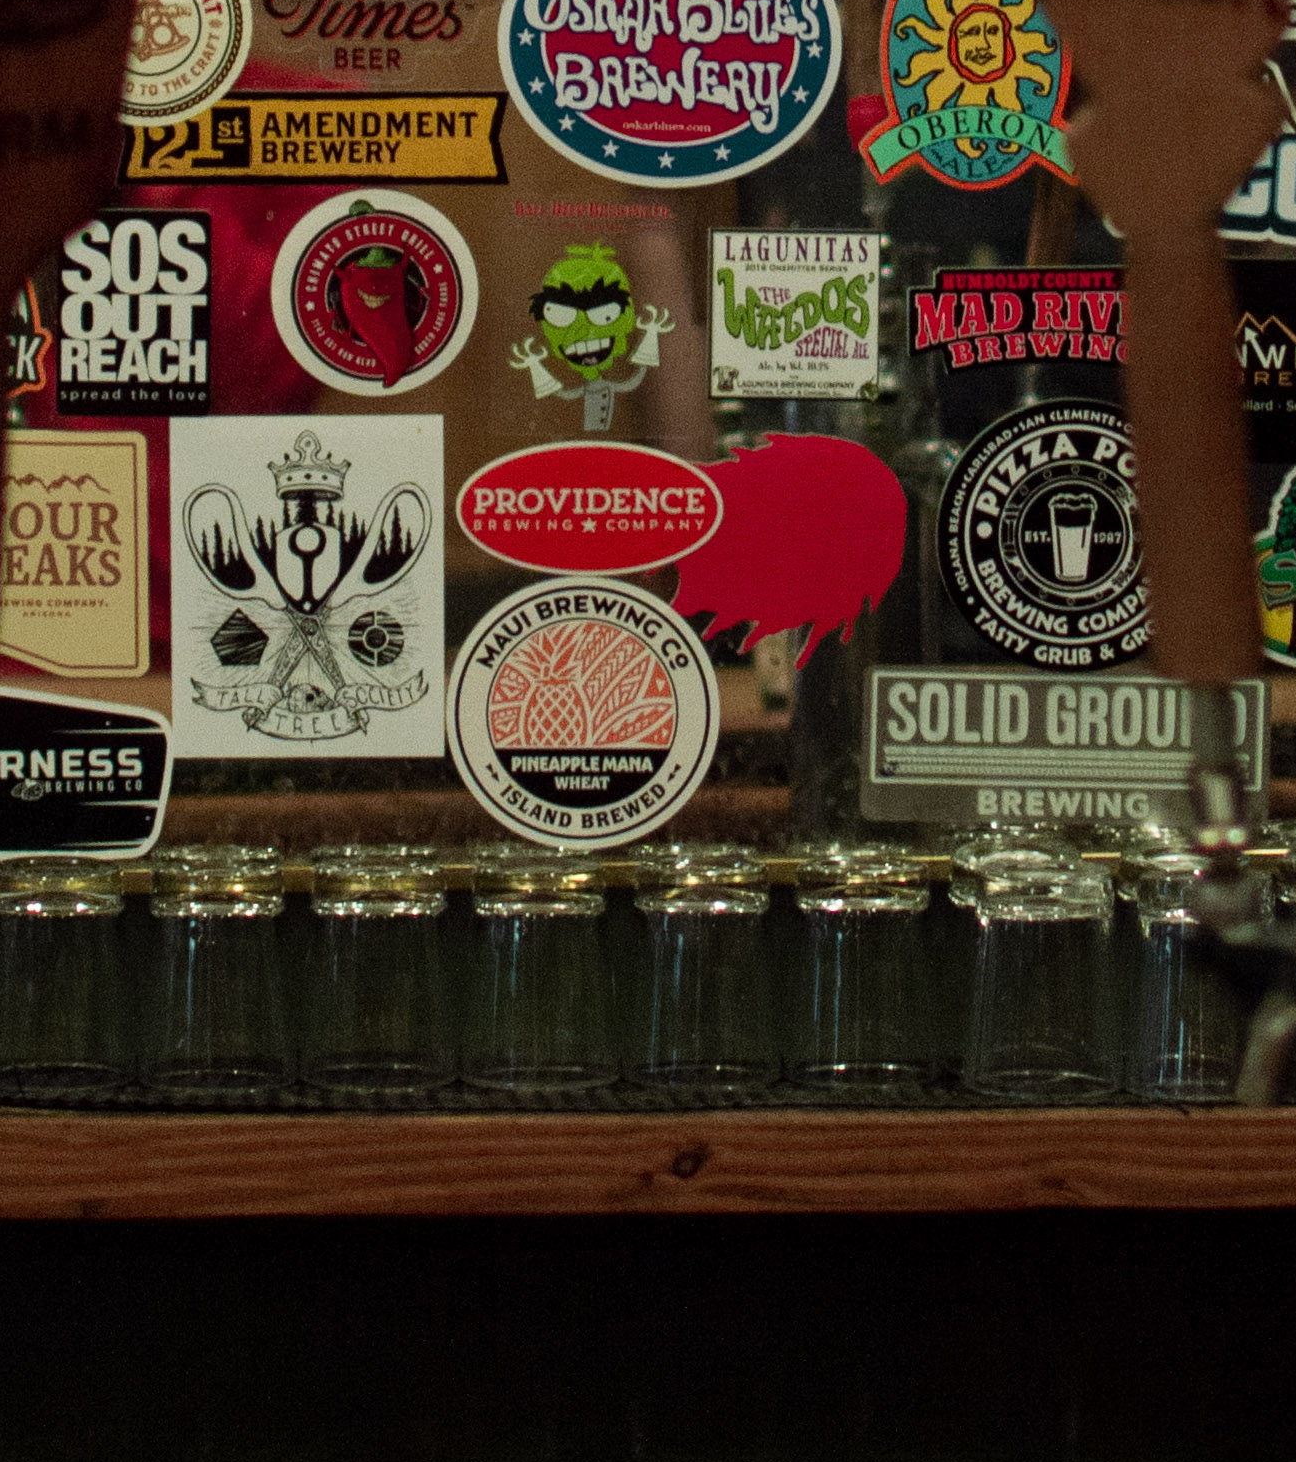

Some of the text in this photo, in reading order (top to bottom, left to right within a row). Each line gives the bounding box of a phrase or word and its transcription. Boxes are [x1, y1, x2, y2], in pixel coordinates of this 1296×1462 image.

[333, 48, 401, 71] BEER
[554, 49, 785, 134] BREWERY
[261, 112, 477, 139] AMENDMENT
[896, 114, 1054, 154] OBERON
[261, 139, 402, 165] BREWERY
[62, 219, 207, 295] SOS
[724, 235, 870, 263] LAGUNITAS
[60, 295, 207, 340] OUT
[60, 339, 207, 384] REACH
[60, 389, 207, 404] spread the love
[472, 488, 706, 516] PROVIDENCE
[472, 518, 705, 532] BREWING COMPANY
[886, 682, 1030, 745] SOLID
[511, 756, 653, 773] PINEAPPLE MANA
[554, 774, 611, 791] WHEAT
[976, 788, 1150, 818] BREWING
